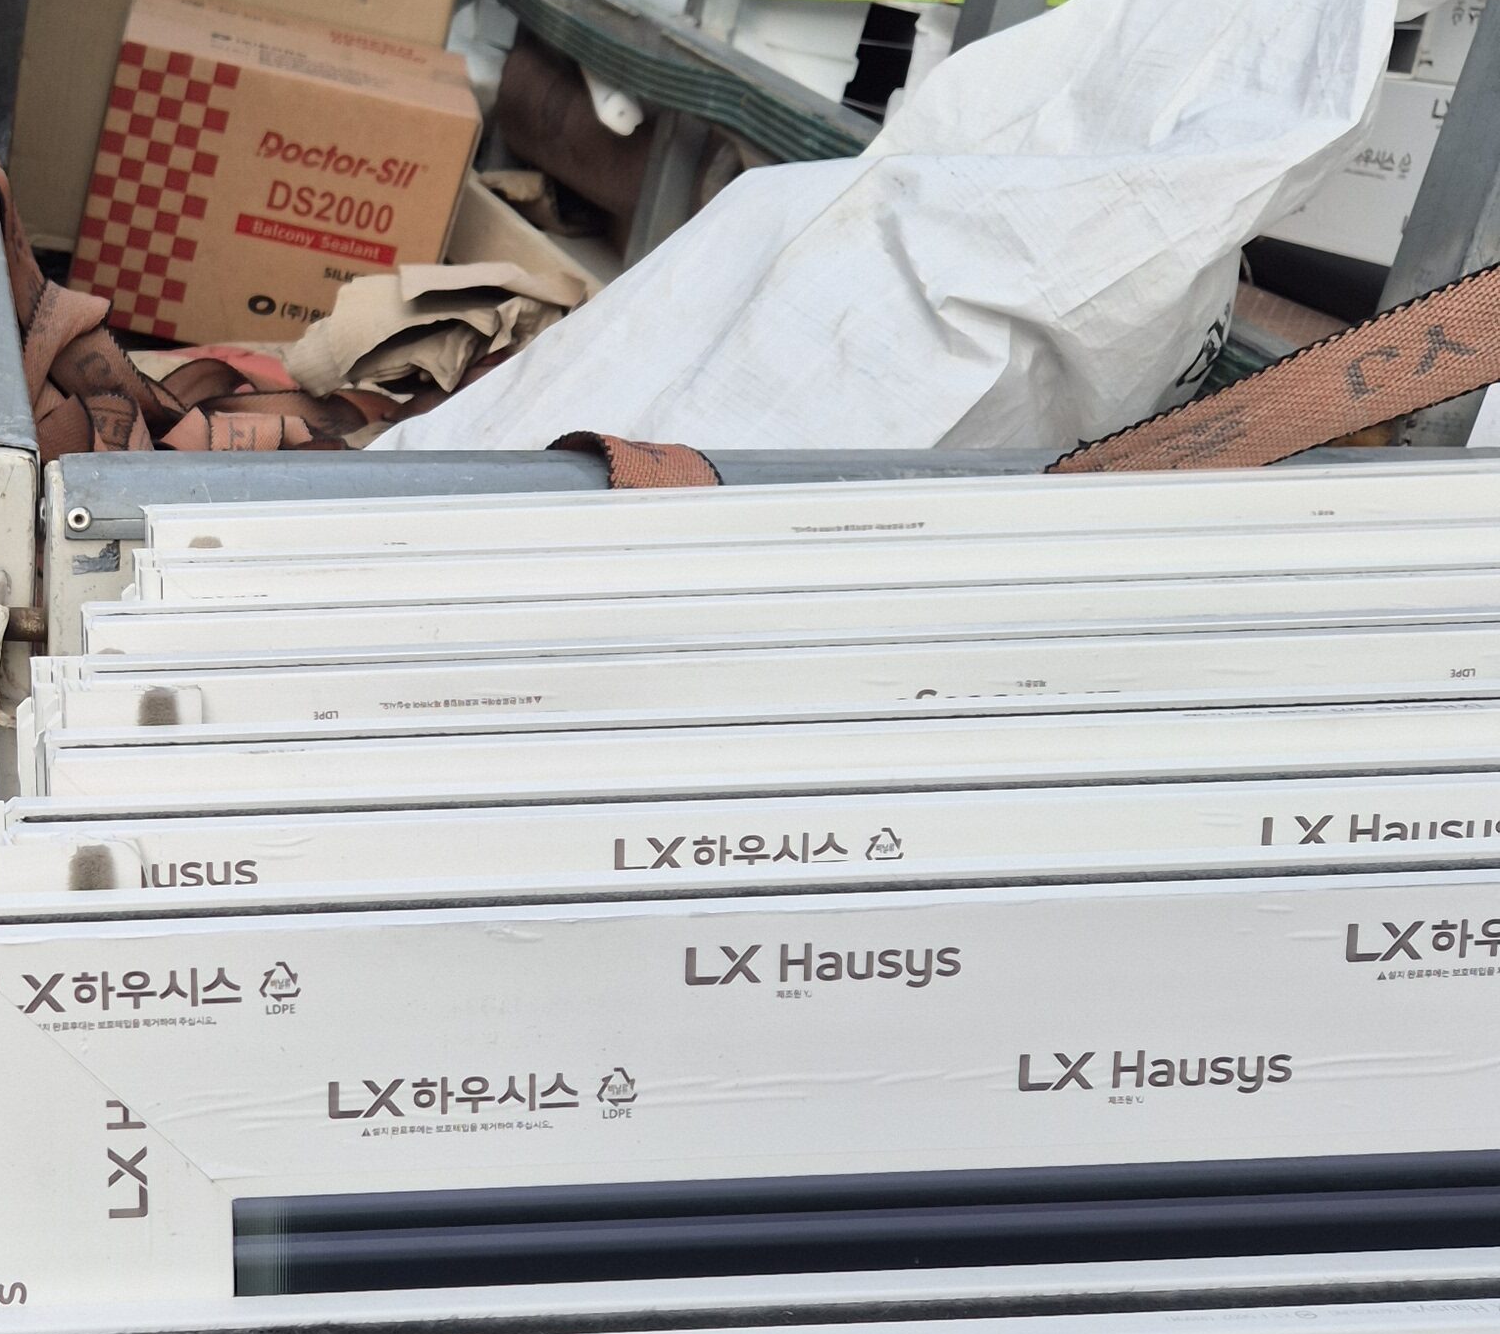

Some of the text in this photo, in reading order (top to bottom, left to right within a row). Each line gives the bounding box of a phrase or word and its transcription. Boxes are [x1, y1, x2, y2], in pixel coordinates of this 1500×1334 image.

[266, 180, 394, 235] DS2000
[252, 220, 381, 260] Balcony Sealant
[1450, 667, 1476, 678] LDPE
[313, 710, 338, 720] LDPE
[1346, 918, 1500, 963] LX하우
[685, 942, 962, 988] LX Hausys
[266, 1003, 296, 1015] LDPE
[1018, 1050, 1293, 1093] LX Hausys
[328, 1073, 580, 1119] LX하우시스
[602, 1108, 632, 1120] LDPE
[106, 1146, 149, 1219] LX
